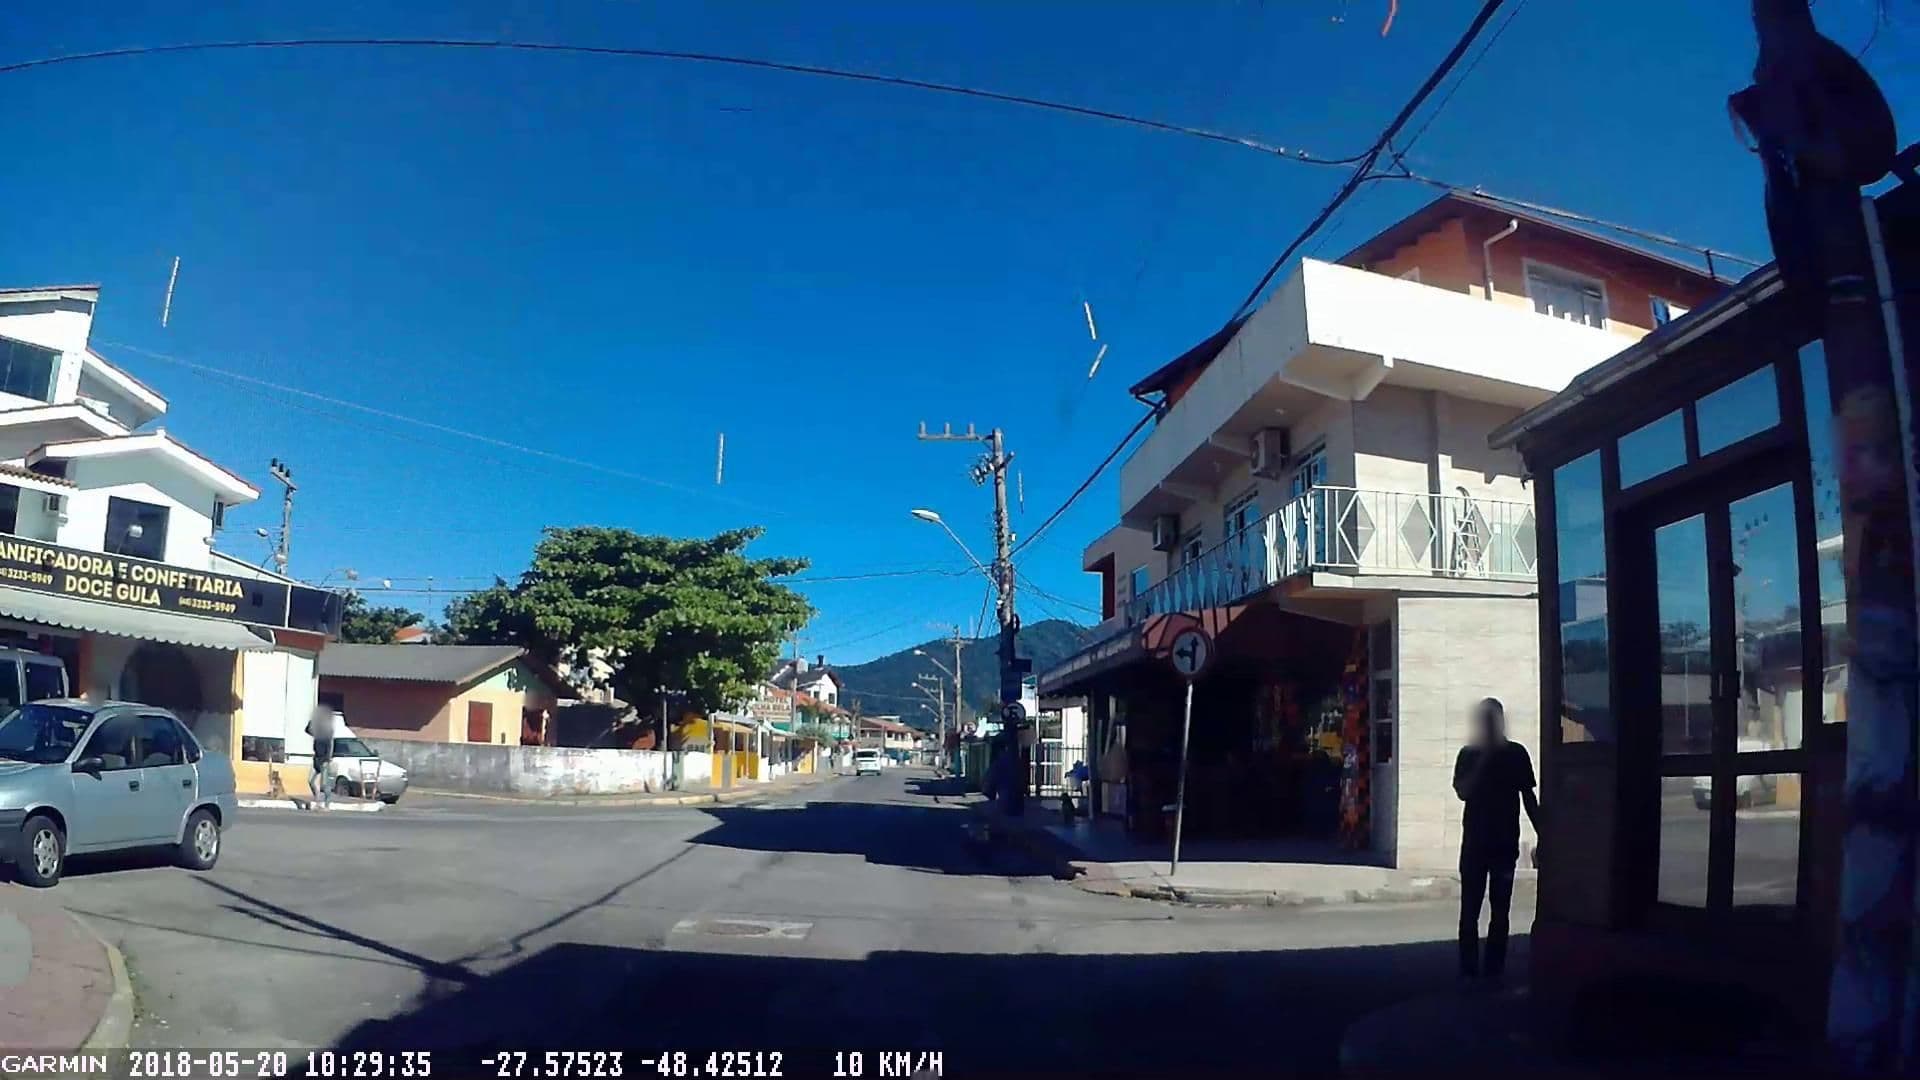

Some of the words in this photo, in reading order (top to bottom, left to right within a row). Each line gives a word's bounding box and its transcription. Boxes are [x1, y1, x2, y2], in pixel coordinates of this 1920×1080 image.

[119, 562, 128, 579] E
[65, 575, 112, 598] DOCE
[117, 583, 160, 606] GULA
